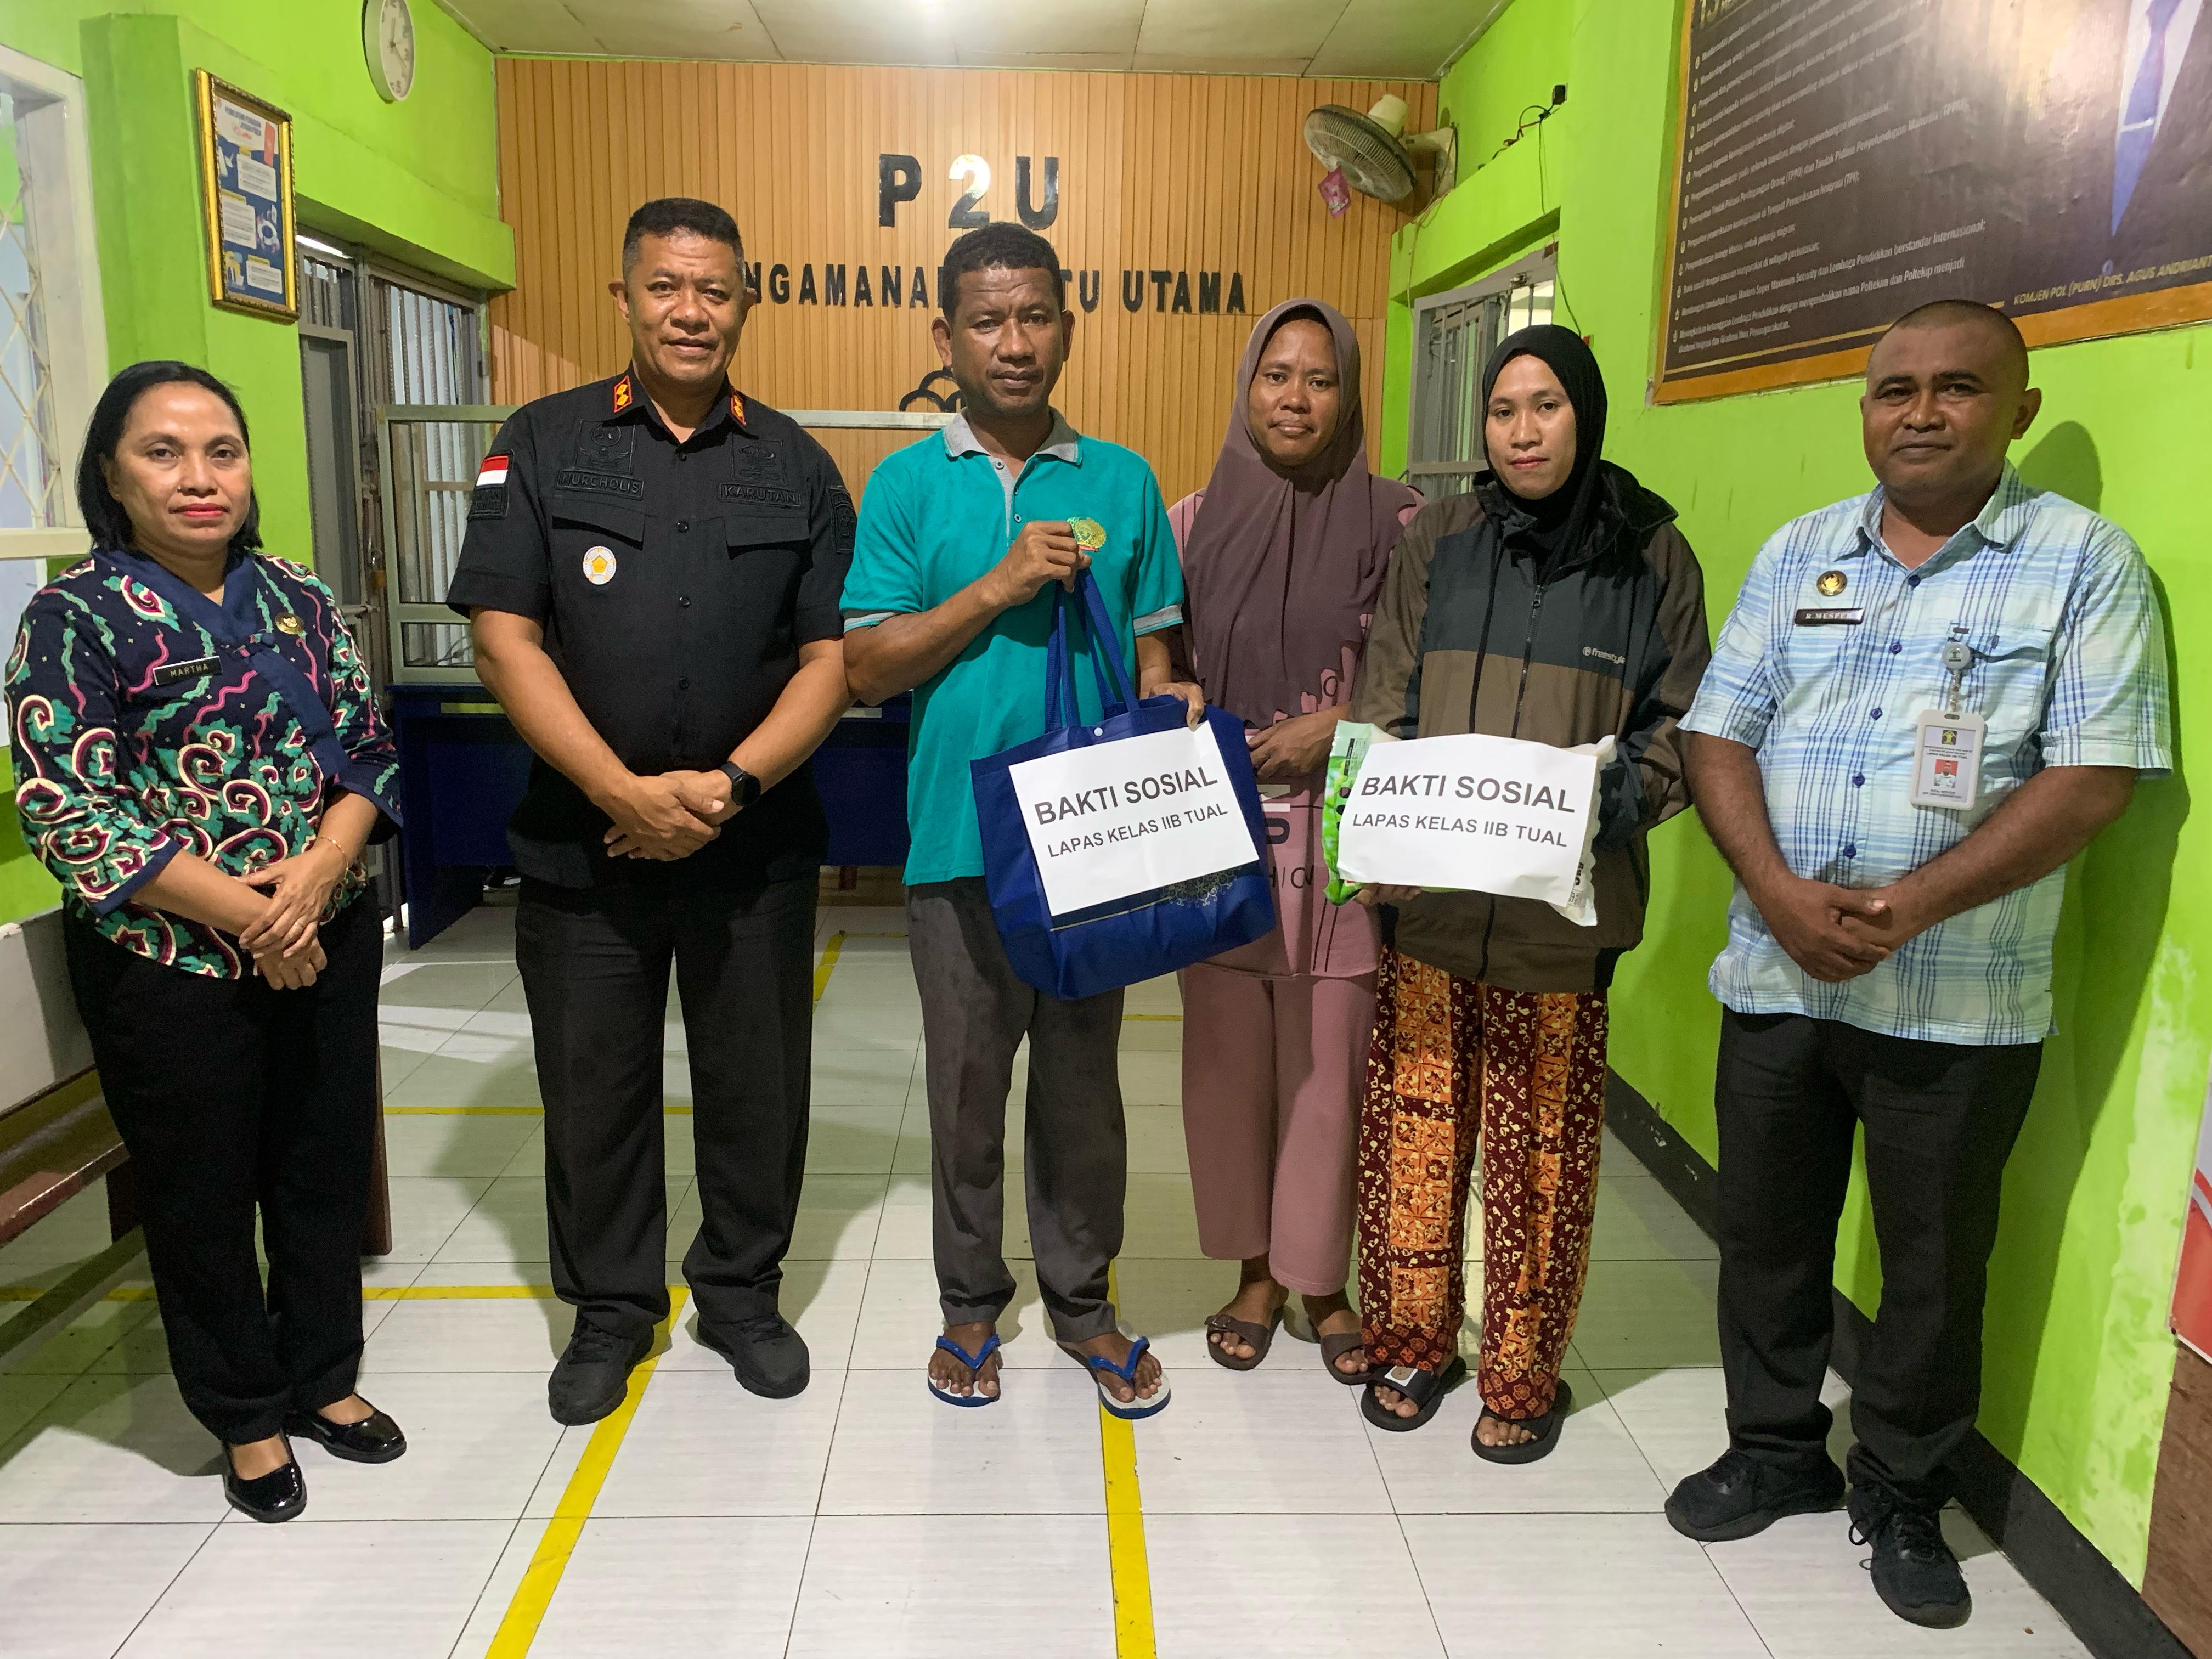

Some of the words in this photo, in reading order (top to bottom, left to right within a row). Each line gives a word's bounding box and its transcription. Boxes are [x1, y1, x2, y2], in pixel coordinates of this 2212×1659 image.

[1796, 267, 1818, 285] Security
[1818, 264, 1829, 276] dan
[1829, 256, 1855, 275] Lembaga
[1857, 244, 1892, 266] Pendidikan
[1894, 234, 1931, 255] berstandar
[1933, 218, 1985, 247] Internasional;
[1123, 270, 1246, 313] UTAMA
[1860, 275, 1888, 293] Poltekim
[1889, 273, 1902, 285] dan
[1904, 263, 1933, 284] Poltekip
[1934, 256, 1965, 277] menjadi
[2013, 289, 2050, 306] KOMJEN
[2068, 276, 2102, 297] (PURN)
[2126, 267, 2157, 283] AGUS
[561, 473, 639, 493] NURCHOLIS
[725, 486, 796, 502] KARUTAN
[170, 663, 209, 677] MARTHA
[1034, 786, 1118, 825] BAKTI
[1125, 766, 1218, 804] SOSIAL
[1361, 775, 1446, 797] BAKTI
[1455, 776, 1575, 813] SOSIAL
[1048, 832, 1104, 857] LAPAS
[1109, 820, 1159, 843] KELAS
[1163, 813, 1182, 830] IIB
[1184, 803, 1228, 825] TUAL
[1353, 813, 1410, 828] LAPAS
[1415, 816, 1477, 833] KELAS
[1483, 821, 1508, 837] IIB
[1515, 825, 1567, 847] TUAL
